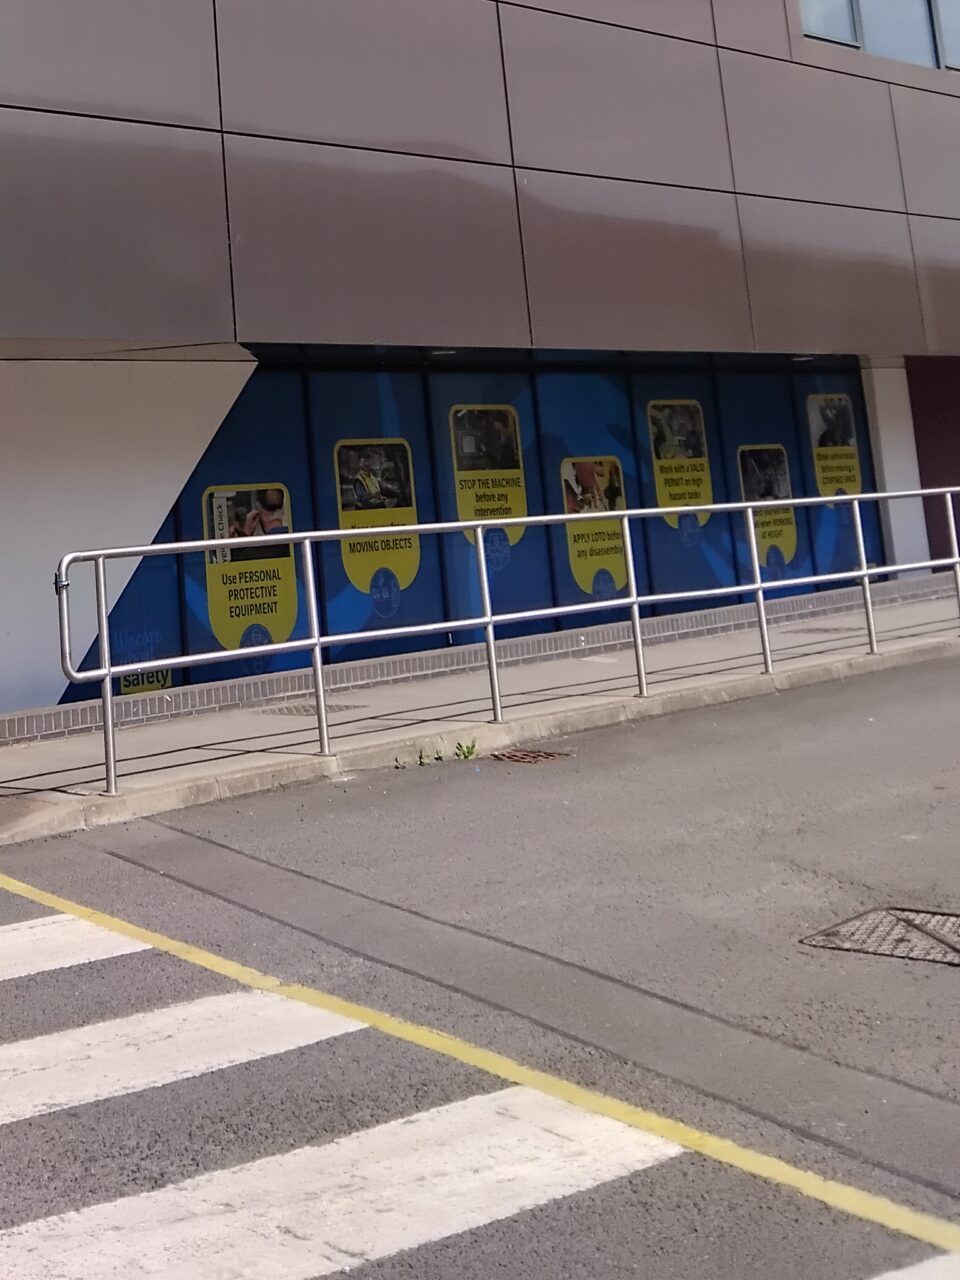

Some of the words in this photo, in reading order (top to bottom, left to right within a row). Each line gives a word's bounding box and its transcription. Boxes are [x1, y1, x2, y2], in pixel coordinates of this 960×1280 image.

[460, 480, 476, 490] STOP
[478, 478, 490, 489] THE
[491, 477, 522, 488] MACHINE
[475, 493, 496, 503] before
[497, 493, 508, 504] any
[474, 505, 512, 517] intervention
[573, 533, 590, 544] APPLY
[591, 531, 605, 543] LOTO
[349, 540, 379, 554] MOVING
[380, 538, 413, 551] OBJECTS
[577, 549, 587, 560] any
[222, 573, 237, 585] Use
[239, 569, 281, 584] PERSONAL
[228, 585, 277, 601] PROTECTIVE
[229, 601, 278, 618] EQUIPMENT
[123, 668, 169, 688] safety
